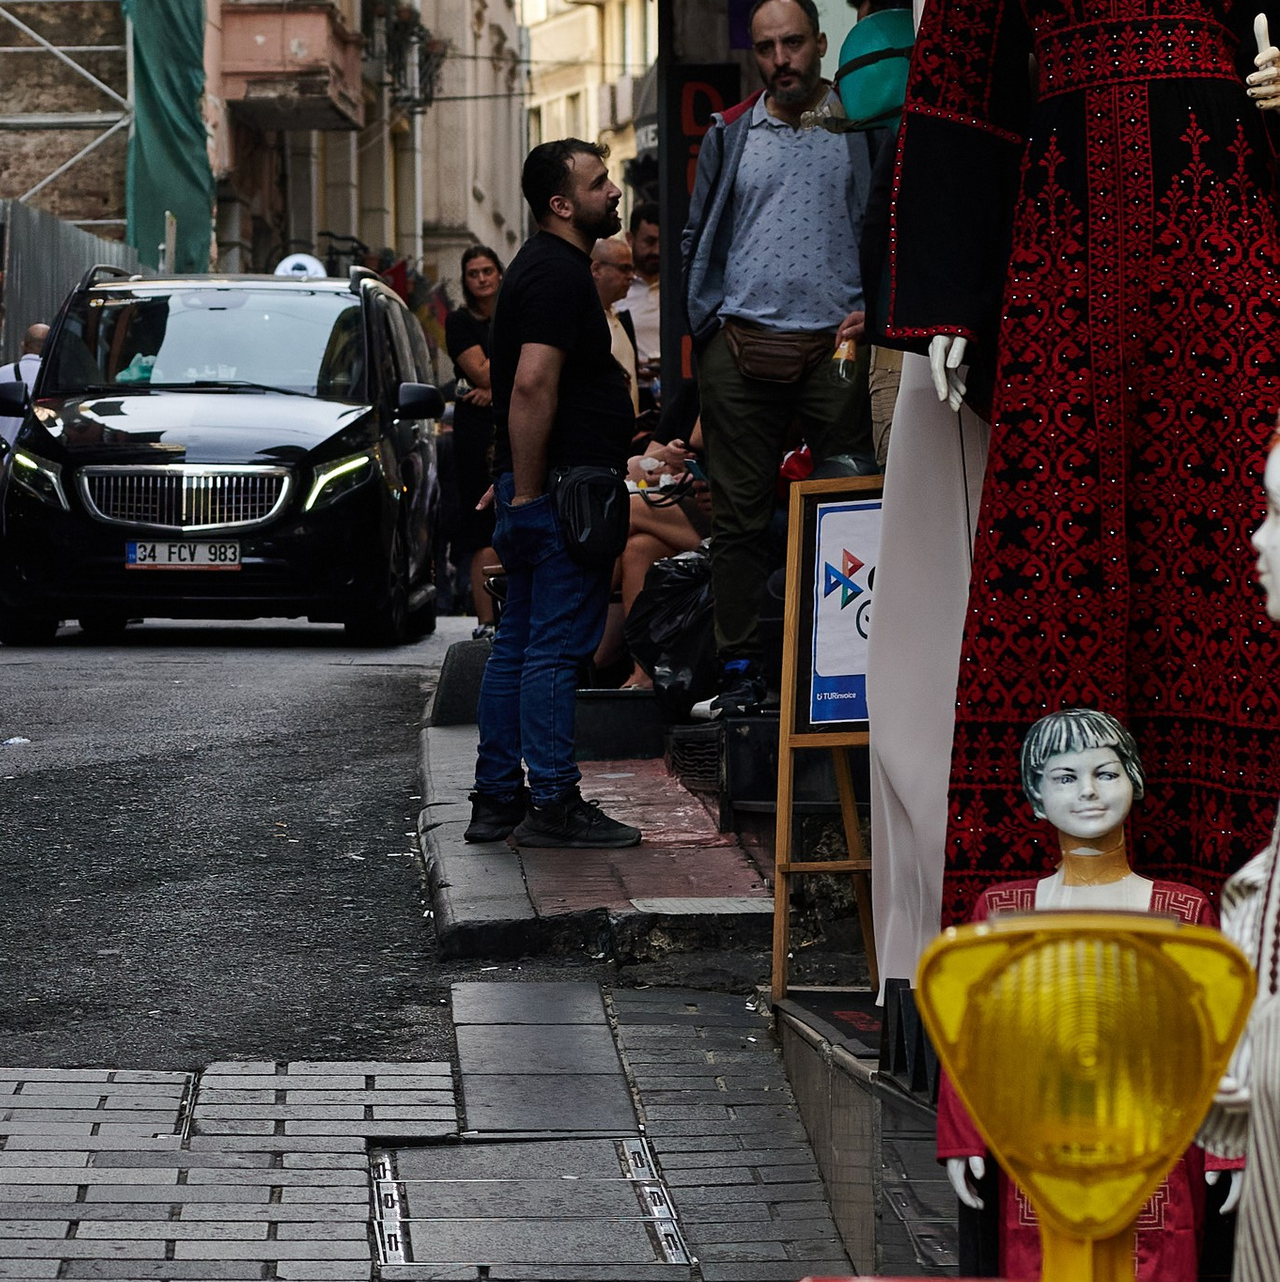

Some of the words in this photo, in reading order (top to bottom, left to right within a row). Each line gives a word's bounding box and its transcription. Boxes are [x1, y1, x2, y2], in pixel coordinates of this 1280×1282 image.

[138, 544, 157, 562] 34
[167, 544, 197, 562] FCV
[208, 544, 238, 562] 983
